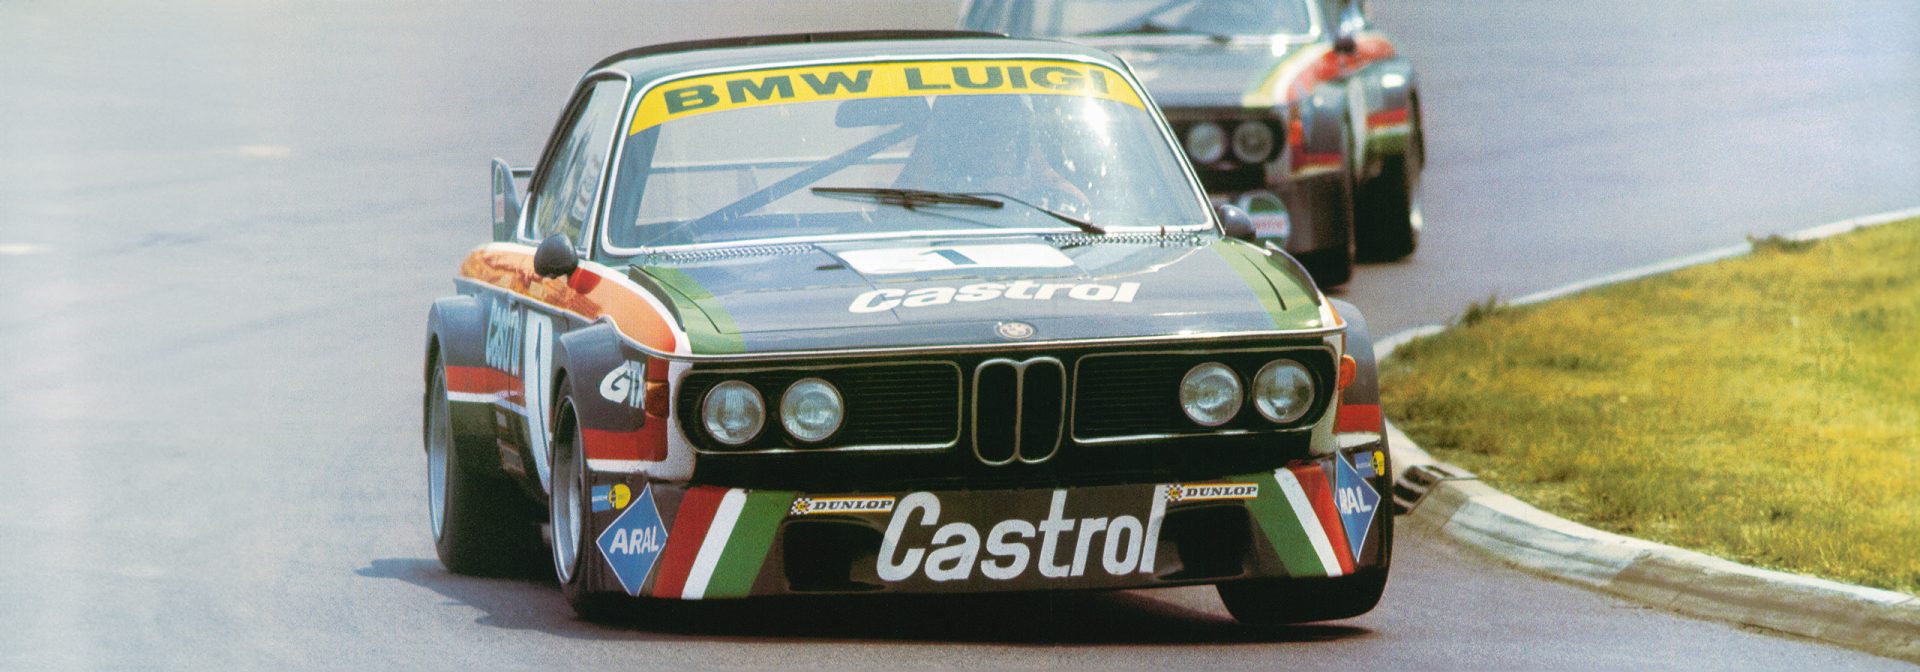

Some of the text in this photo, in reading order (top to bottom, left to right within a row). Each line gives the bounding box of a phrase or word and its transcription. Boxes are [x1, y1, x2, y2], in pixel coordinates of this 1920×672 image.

[664, 66, 1109, 114] BMW LUIGI
[920, 249, 977, 265] 1
[849, 280, 1140, 313] Castrol
[600, 360, 645, 410] GTX
[813, 500, 893, 510] DUNLOP
[1186, 486, 1257, 497] DUNLOP
[609, 525, 659, 554] ARAL
[876, 484, 1168, 581] Castrol
